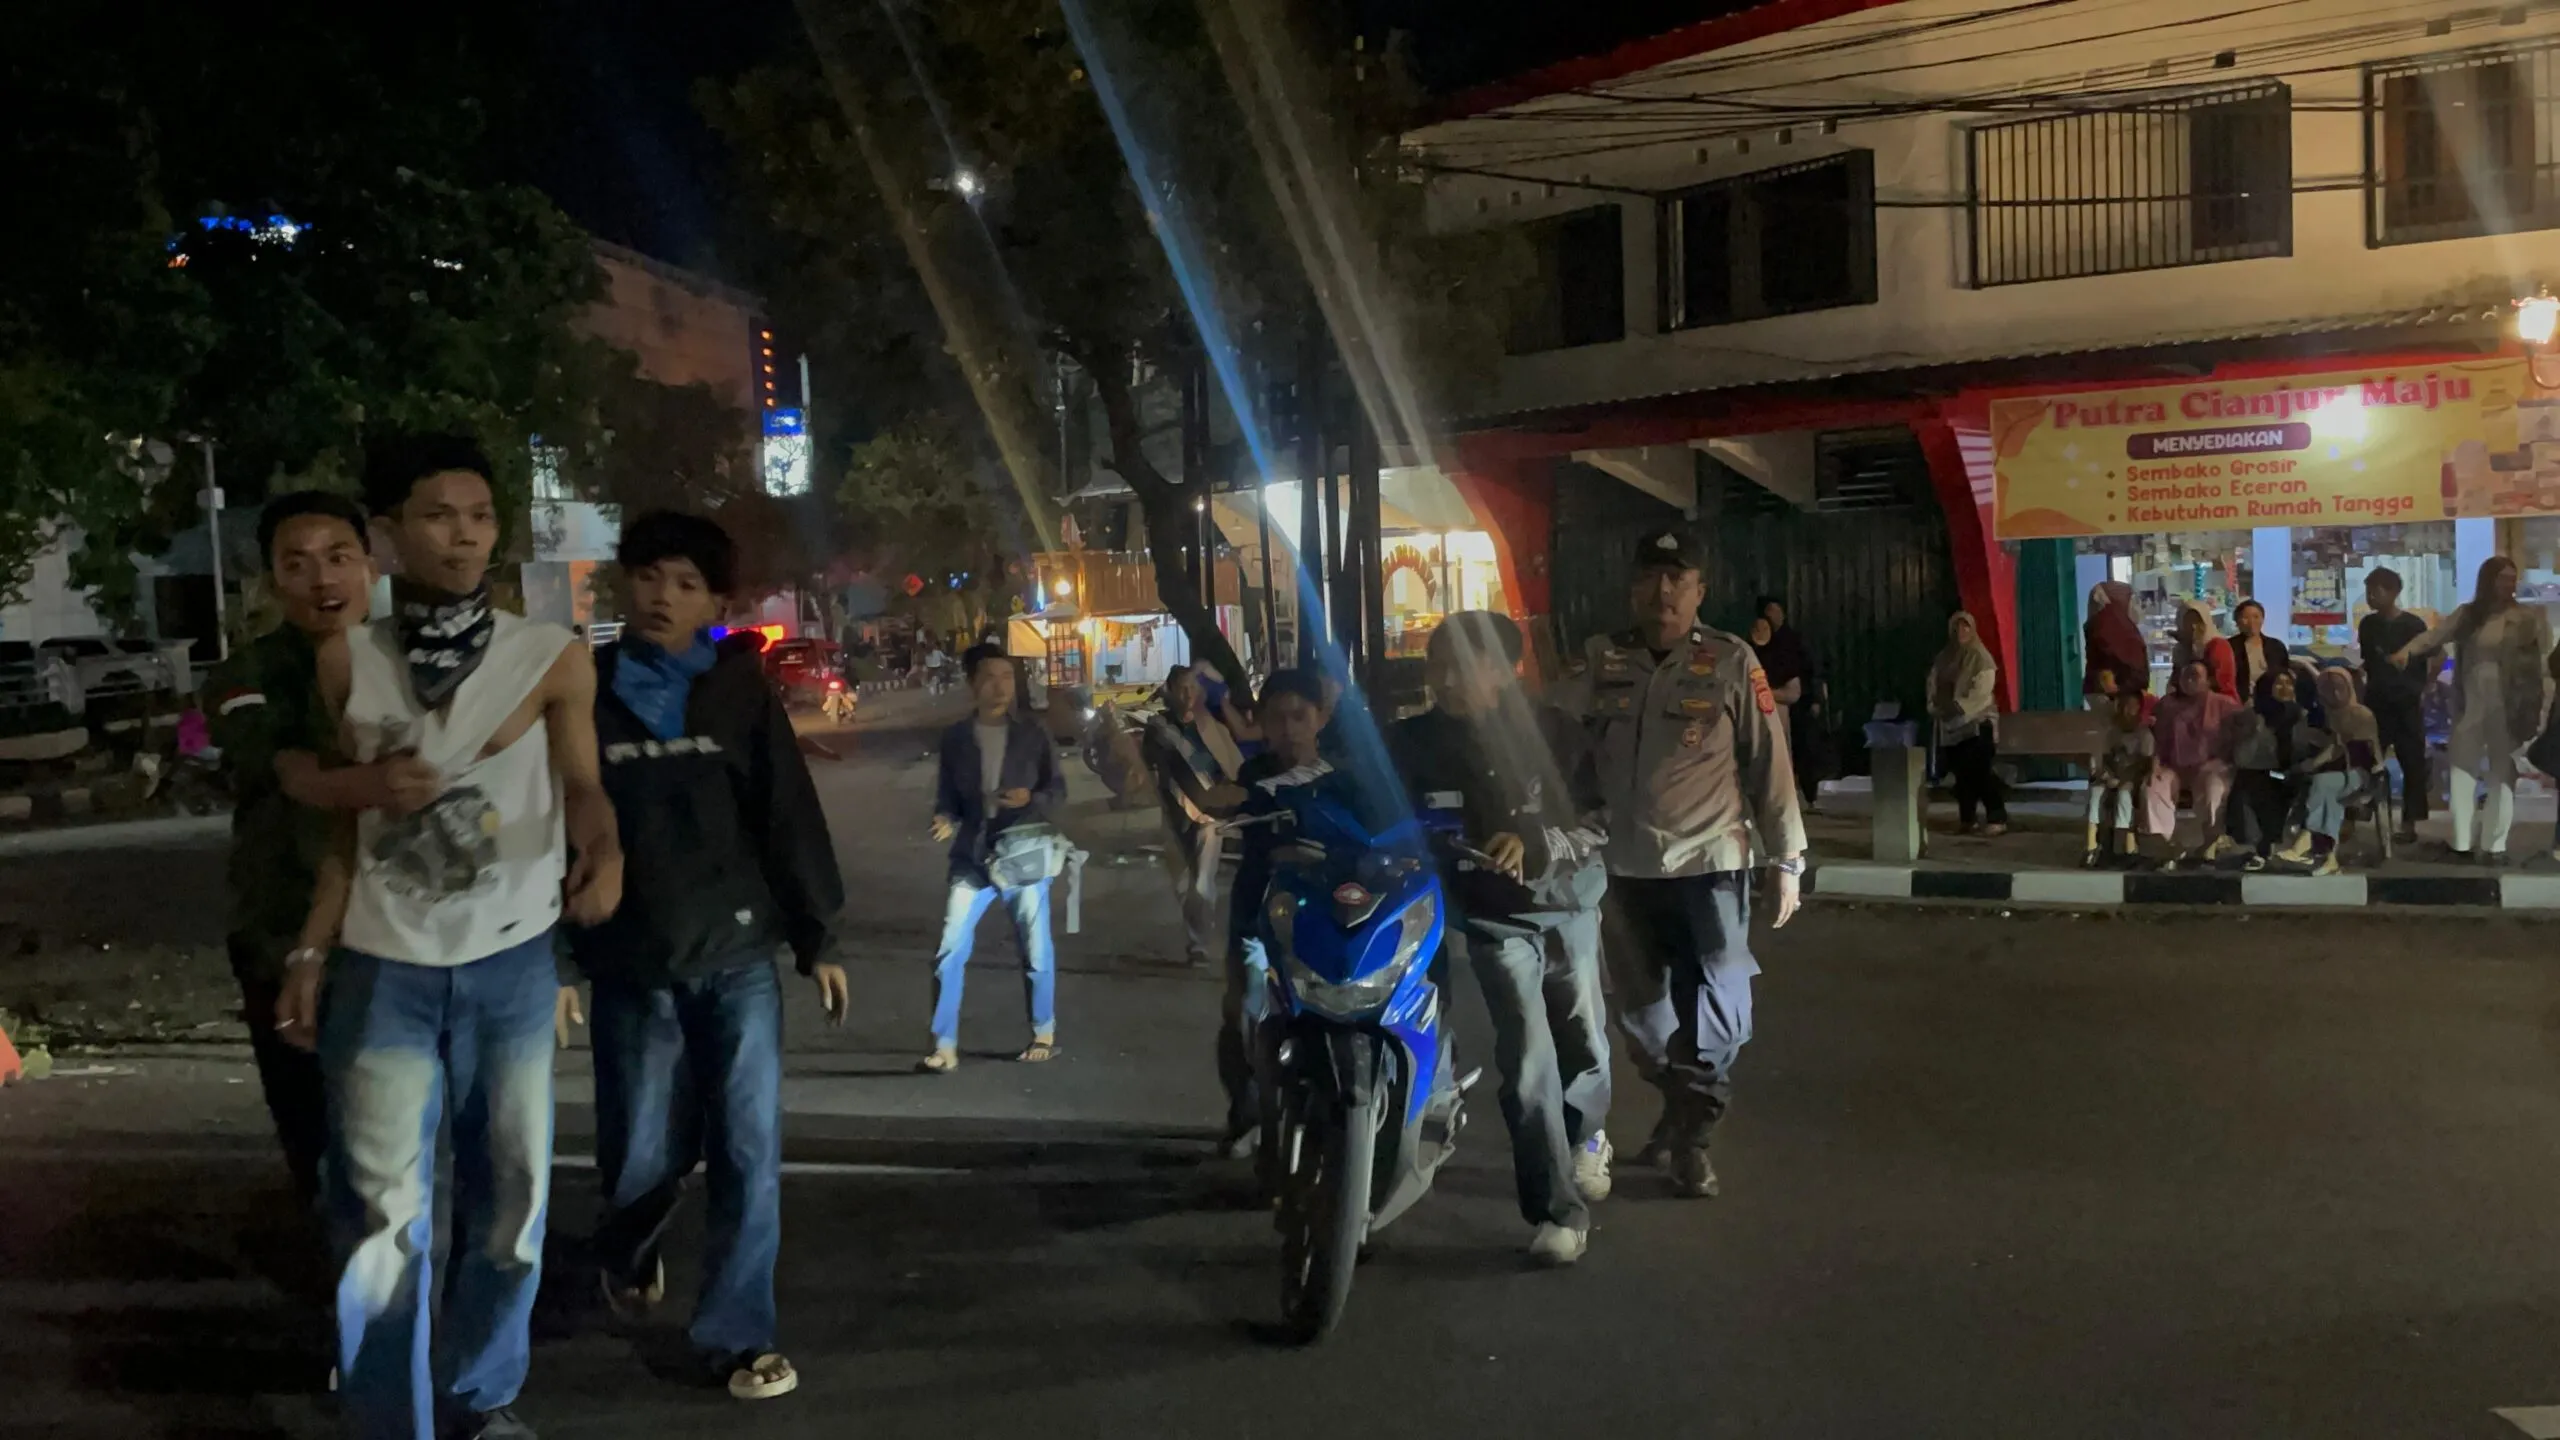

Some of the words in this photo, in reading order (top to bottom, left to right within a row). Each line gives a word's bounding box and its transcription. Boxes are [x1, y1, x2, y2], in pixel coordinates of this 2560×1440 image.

[2053, 396, 2168, 429] Putra
[2361, 371, 2473, 410] Maju
[2153, 429, 2284, 453] MENYEDIAKAN
[2127, 462, 2222, 482] Sembako
[2229, 458, 2298, 477] Grosir
[2127, 482, 2222, 502] Sembako
[2229, 479, 2307, 497] Eceran
[2127, 503, 2239, 523] Kebutuhan
[2247, 497, 2322, 517] Rumah
[2332, 494, 2415, 517] Tangga
